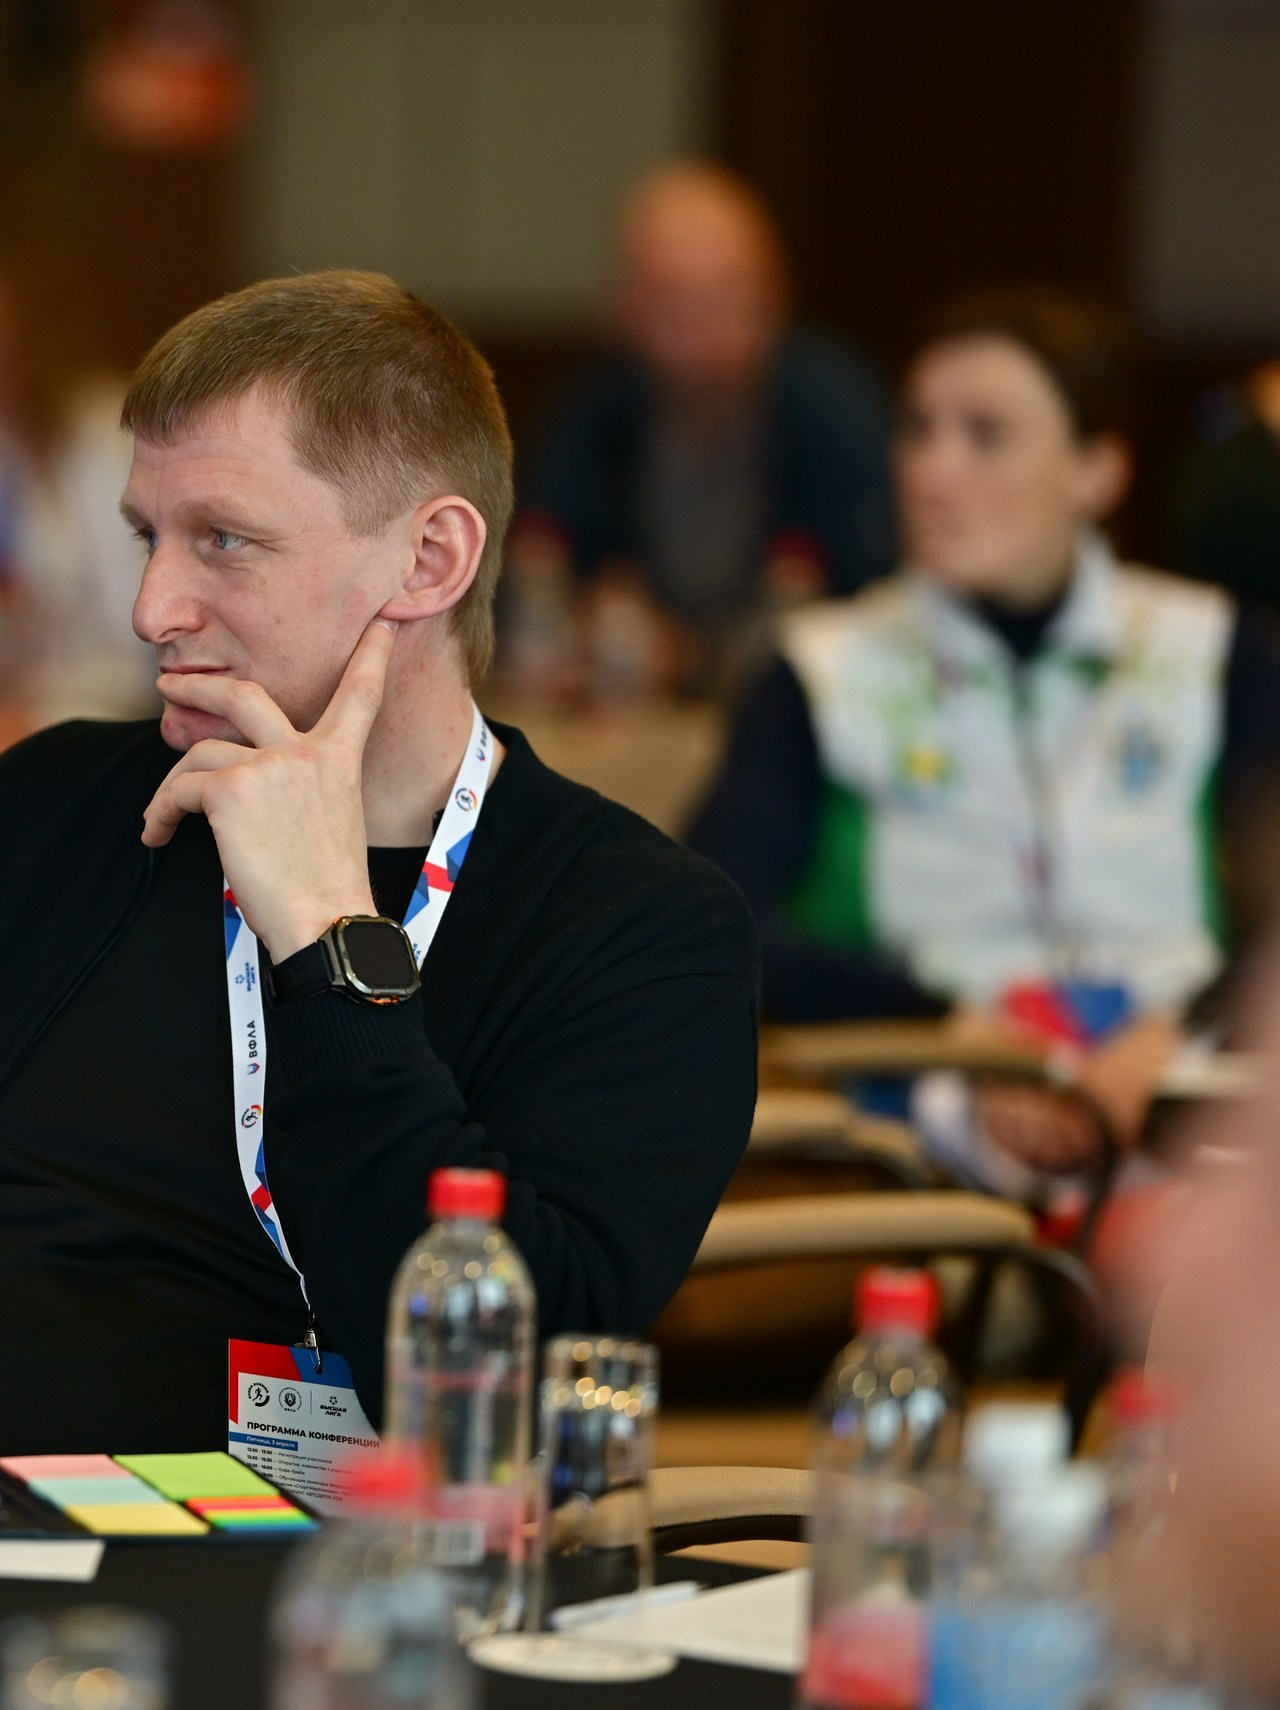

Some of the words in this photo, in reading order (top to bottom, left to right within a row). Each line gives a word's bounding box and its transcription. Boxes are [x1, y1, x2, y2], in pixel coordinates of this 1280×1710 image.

[246, 1020, 258, 1058] ВФЛА
[320, 1404, 347, 1413] ВЫСШАЯ
[247, 1421, 306, 1438] ПРОГРАММА
[308, 1431, 380, 1449] КОНФЕРЕНЦИИ
